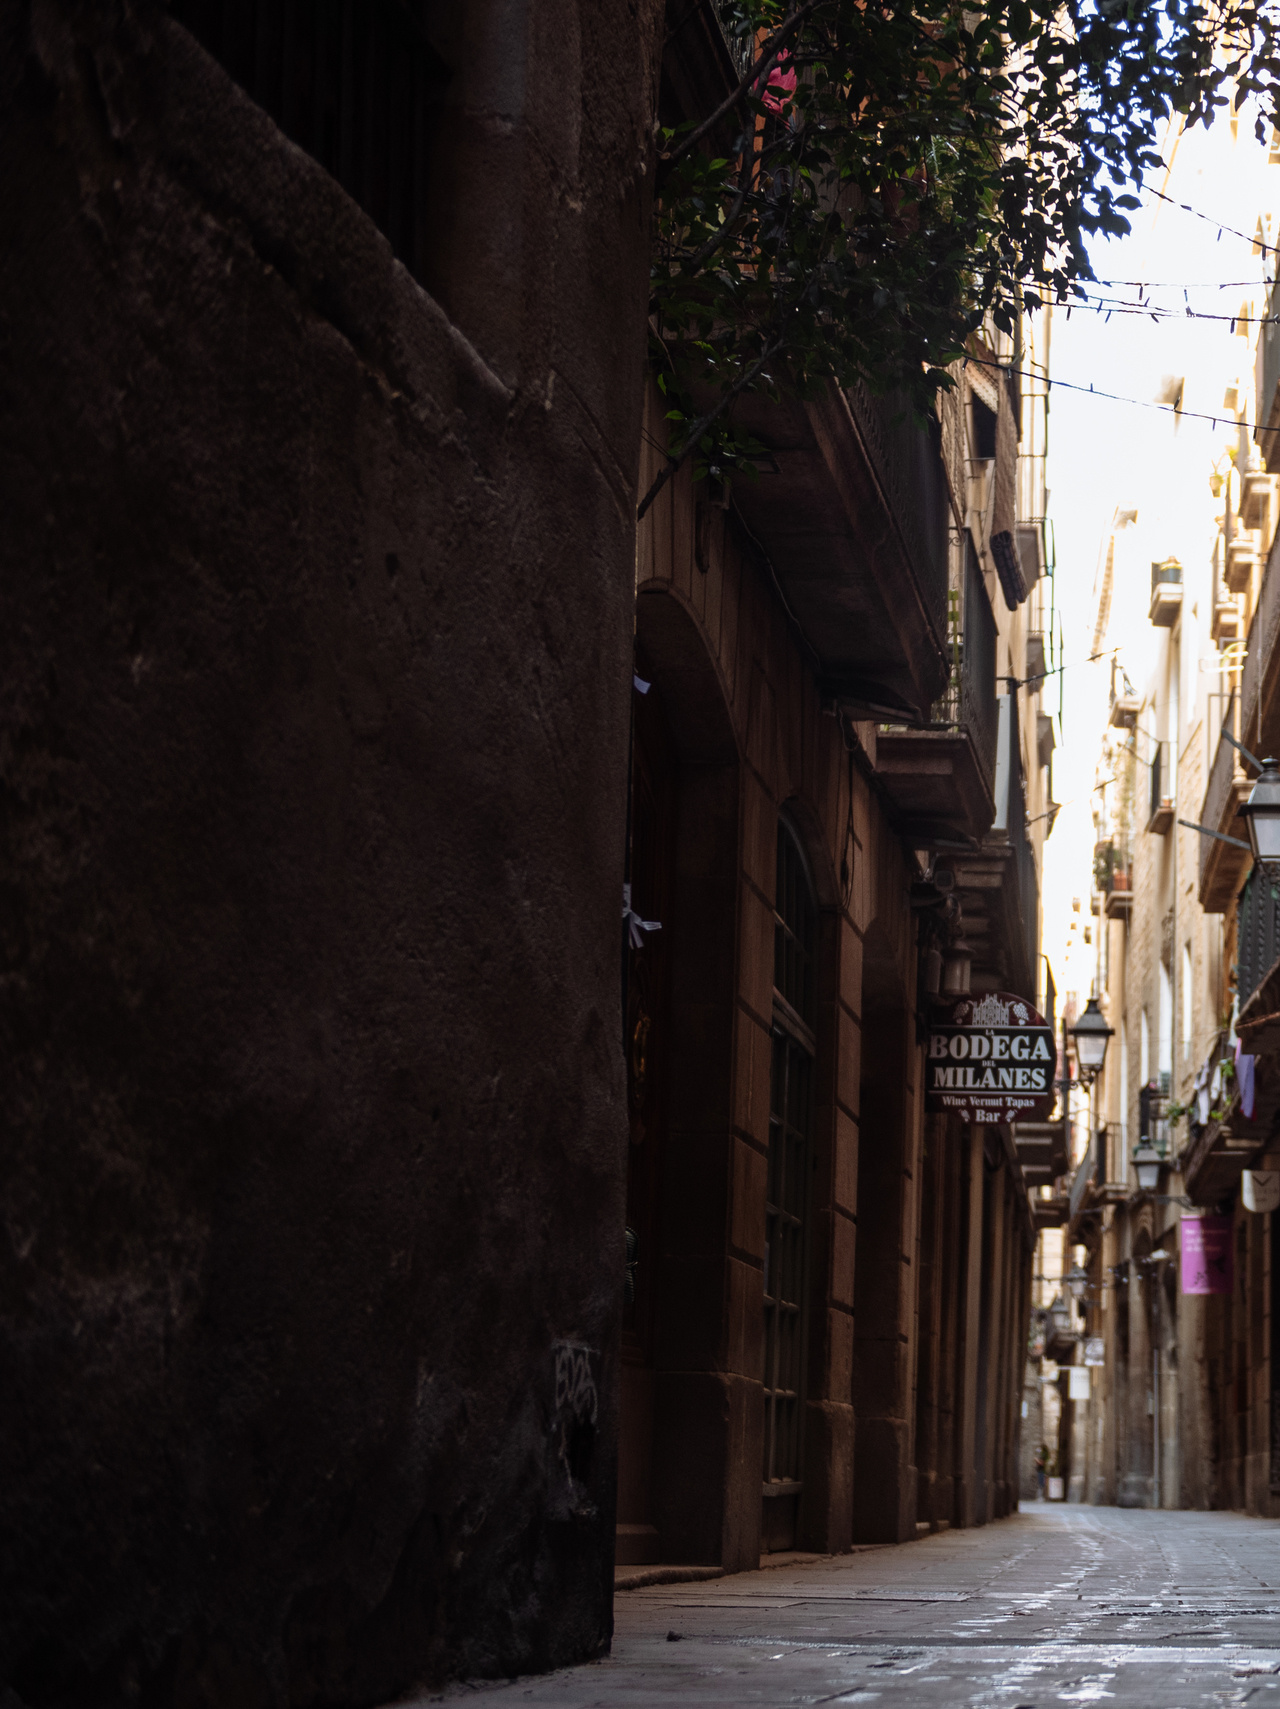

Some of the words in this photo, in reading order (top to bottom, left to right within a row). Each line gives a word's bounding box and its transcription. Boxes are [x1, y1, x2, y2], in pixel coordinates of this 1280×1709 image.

[928, 1034, 1052, 1061] BODEGA
[933, 1066, 1047, 1090] MILANES
[942, 1095, 967, 1107] Wine
[969, 1096, 1003, 1107] Vermut
[1005, 1096, 1036, 1109] Tapas
[975, 1109, 1001, 1123] Bar
